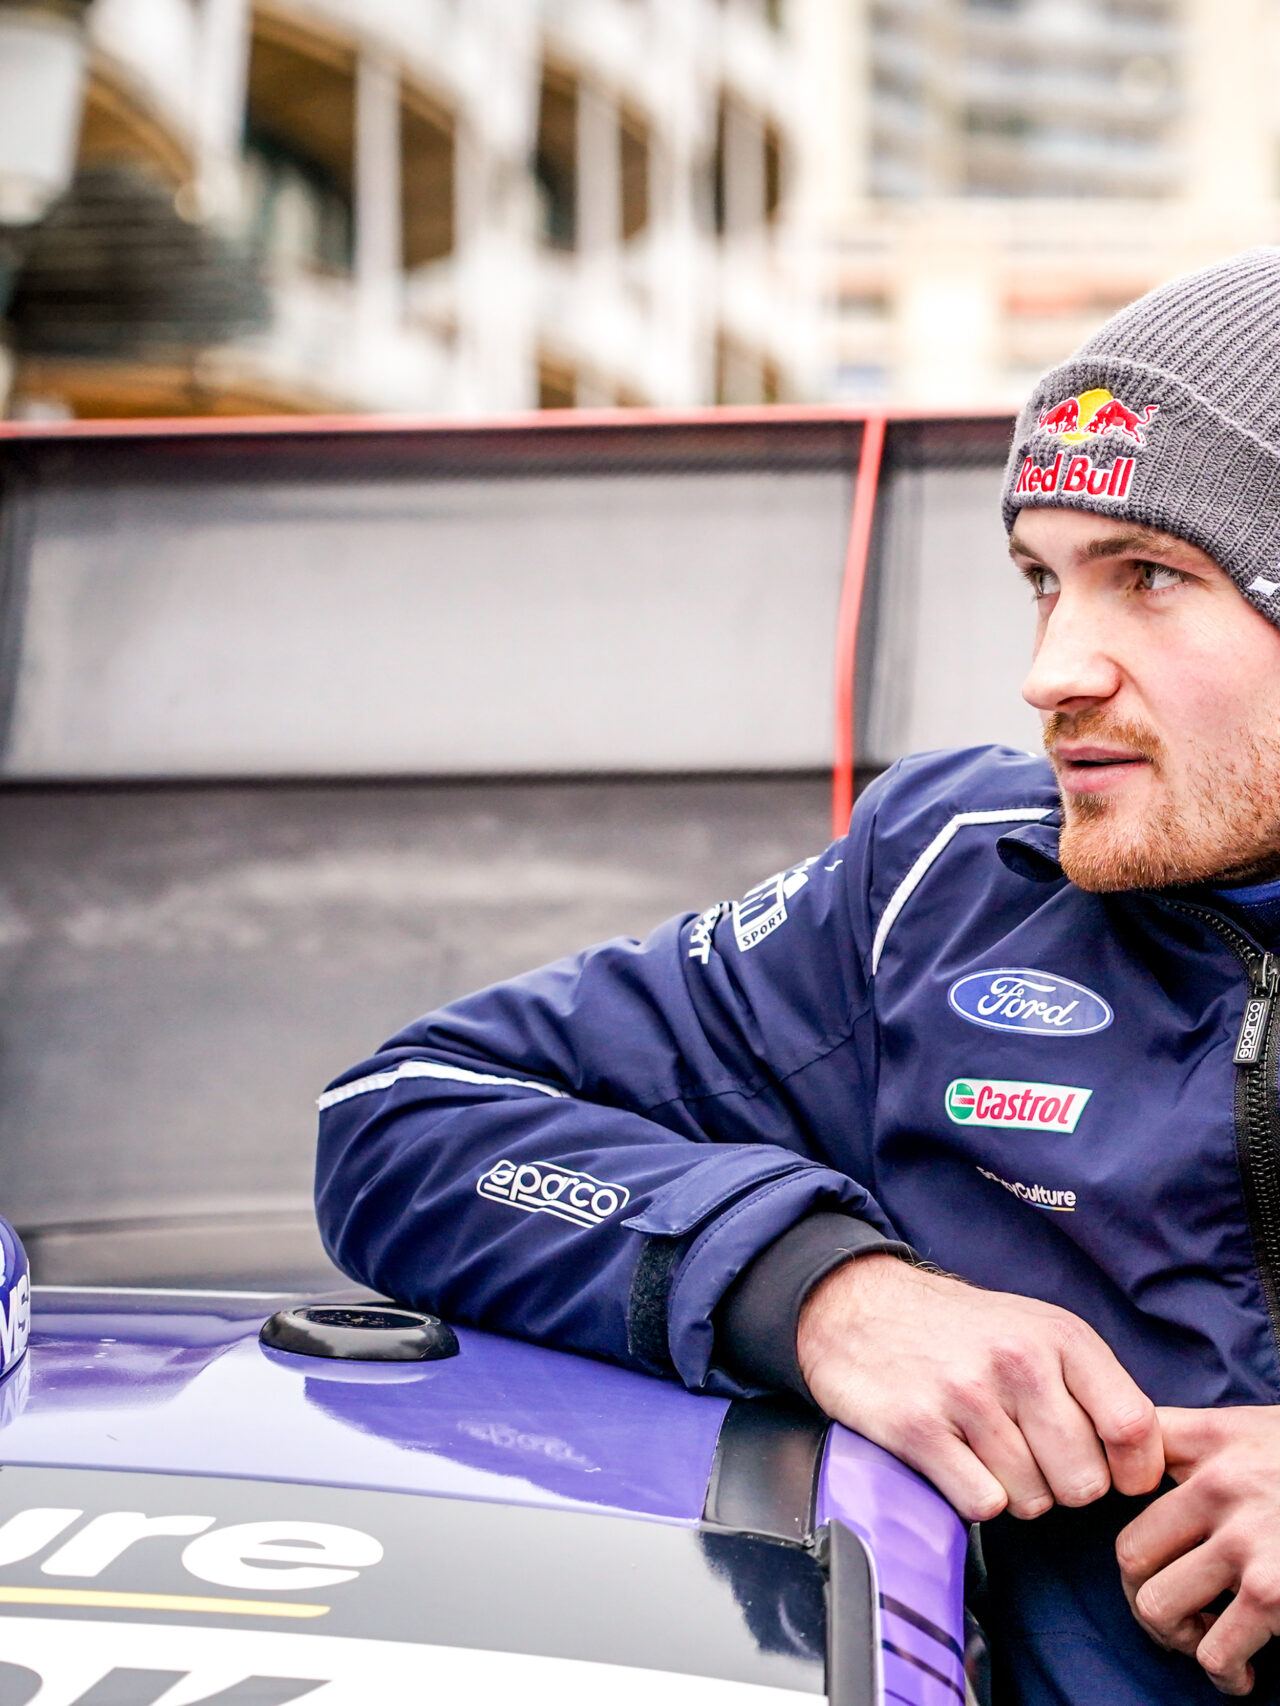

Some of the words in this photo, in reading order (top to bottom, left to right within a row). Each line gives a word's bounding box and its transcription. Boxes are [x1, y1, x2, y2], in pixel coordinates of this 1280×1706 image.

[1014, 451, 1064, 495] Red
[1062, 455, 1134, 498] Bull
[742, 910, 782, 947] SPORT
[977, 976, 1080, 1027] Ford
[1239, 1002, 1261, 1058] sparco
[976, 1085, 1076, 1125] Castrol
[489, 1163, 618, 1217] sparco
